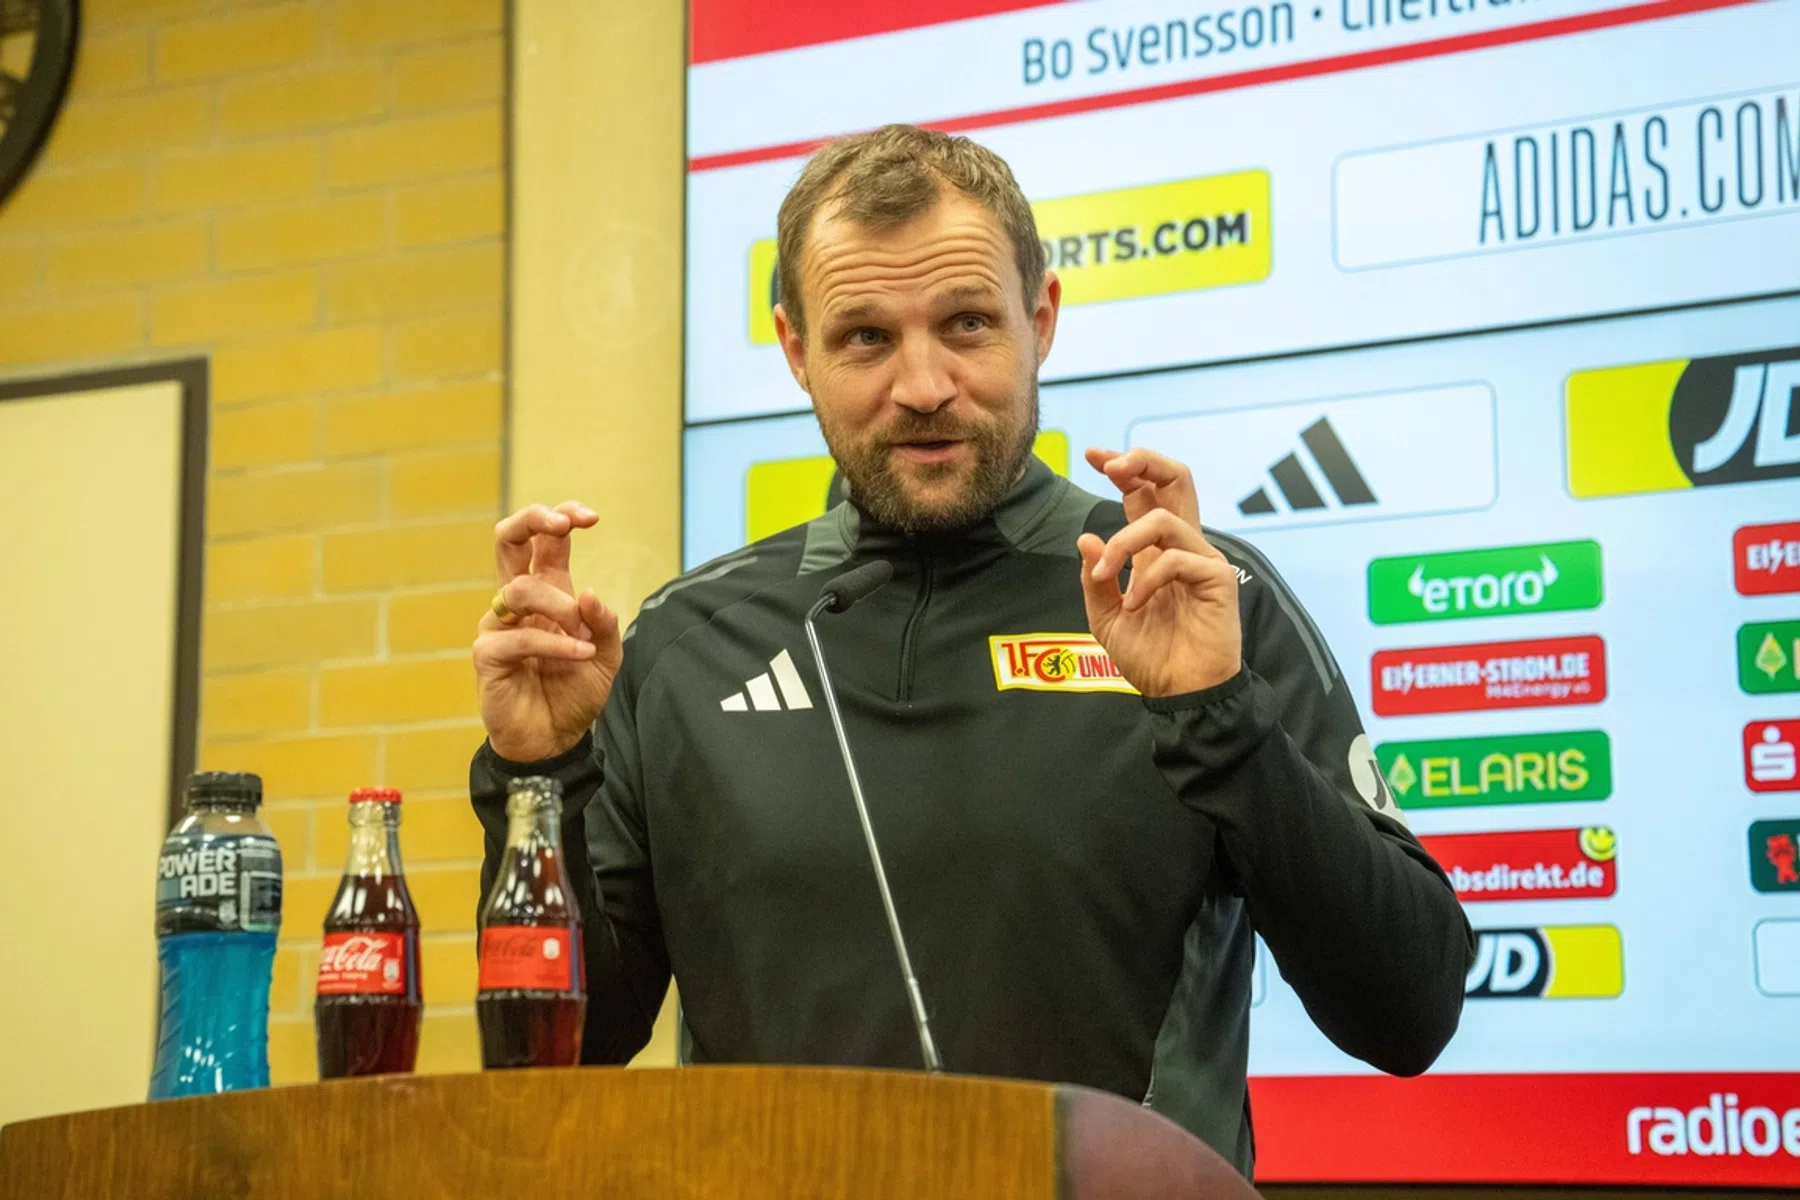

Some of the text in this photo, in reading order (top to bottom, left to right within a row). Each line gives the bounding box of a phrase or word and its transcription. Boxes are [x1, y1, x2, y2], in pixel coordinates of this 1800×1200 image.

[1022, 37, 1073, 85] Bo
[1086, 1, 1295, 75] Svensson
[1421, 747, 1589, 797] ELARIS
[180, 872, 236, 898] ADE
